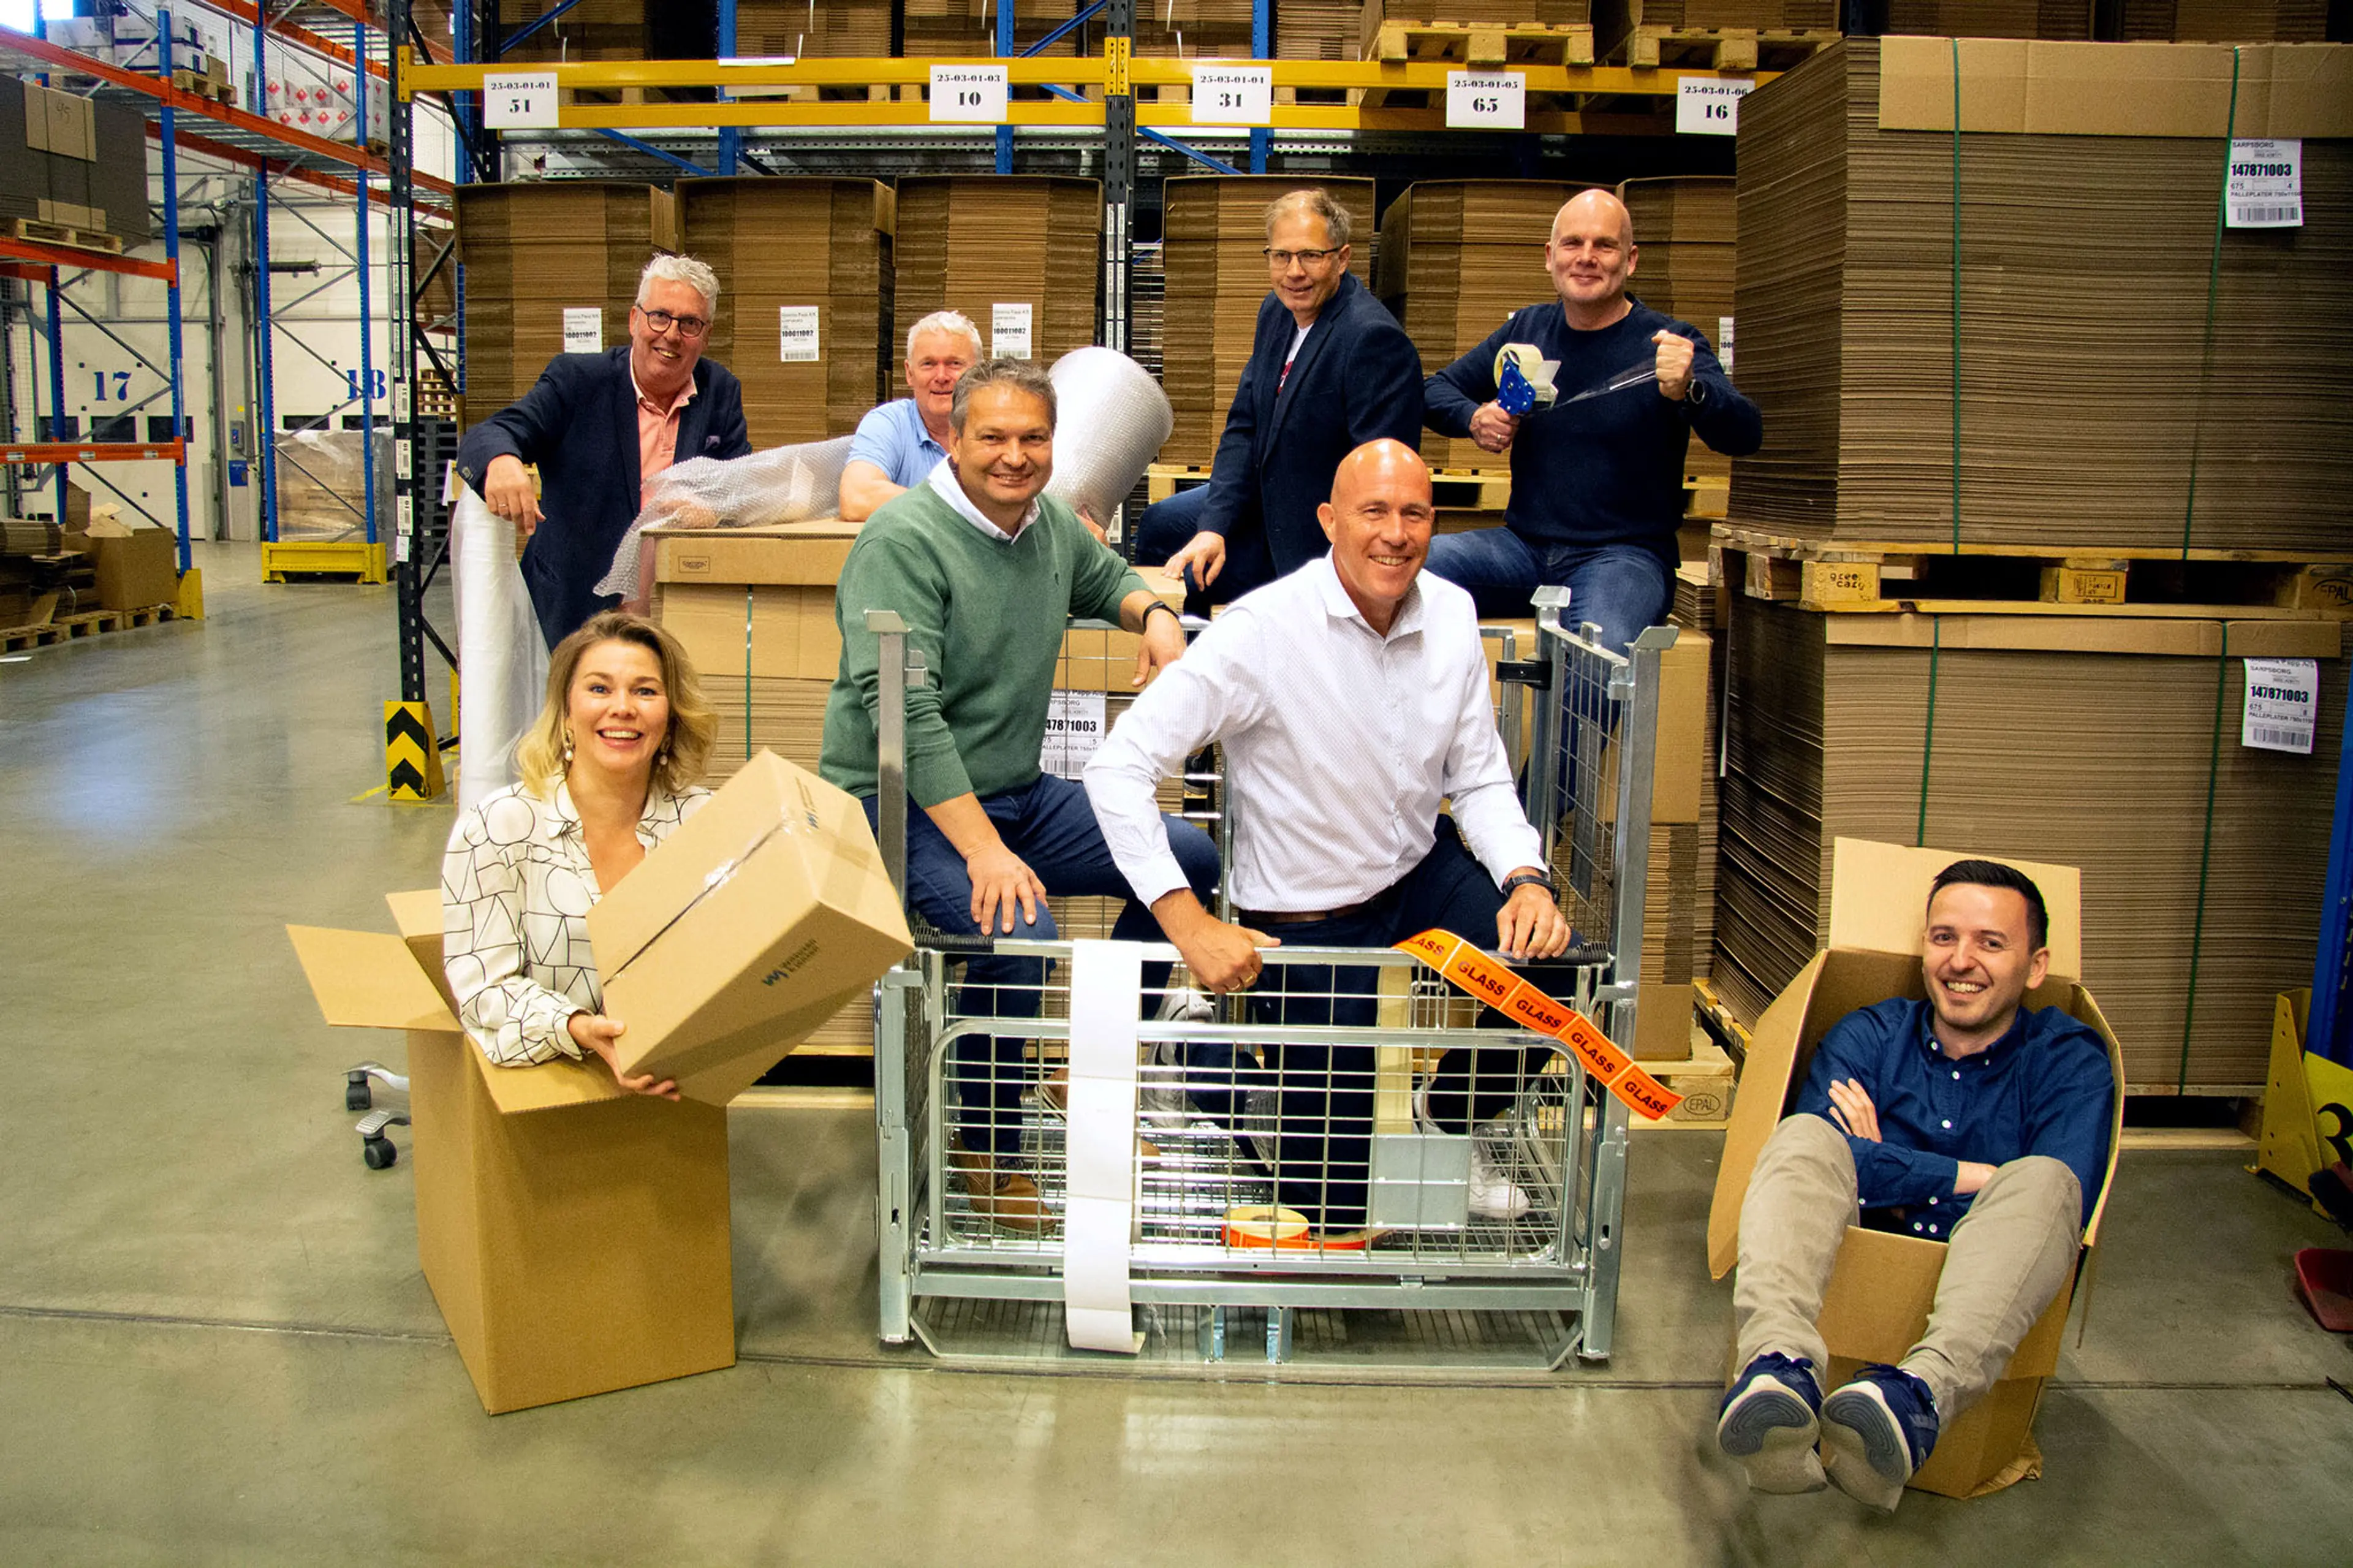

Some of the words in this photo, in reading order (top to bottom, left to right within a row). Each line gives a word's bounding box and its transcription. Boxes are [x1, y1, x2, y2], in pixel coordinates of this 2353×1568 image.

[491, 81, 550, 90] 25-03-01-01
[1454, 80, 1518, 89] 25-03-01-05
[509, 99, 530, 113] 51
[959, 92, 981, 106] 10
[1219, 93, 1241, 108] 31
[1472, 97, 1498, 113] 65
[1706, 104, 1729, 119] 16
[2231, 164, 2292, 177] 147871003
[94, 371, 132, 401] 17
[2250, 685, 2309, 703] 147871003
[1046, 719, 1097, 732] 47871003
[1457, 961, 1506, 996] GLASS
[1516, 999, 1562, 1028] GLASS
[1571, 1032, 1616, 1073] GLASS
[1624, 1081, 1667, 1113] GLASS
[1689, 1097, 1714, 1112] EPAL
